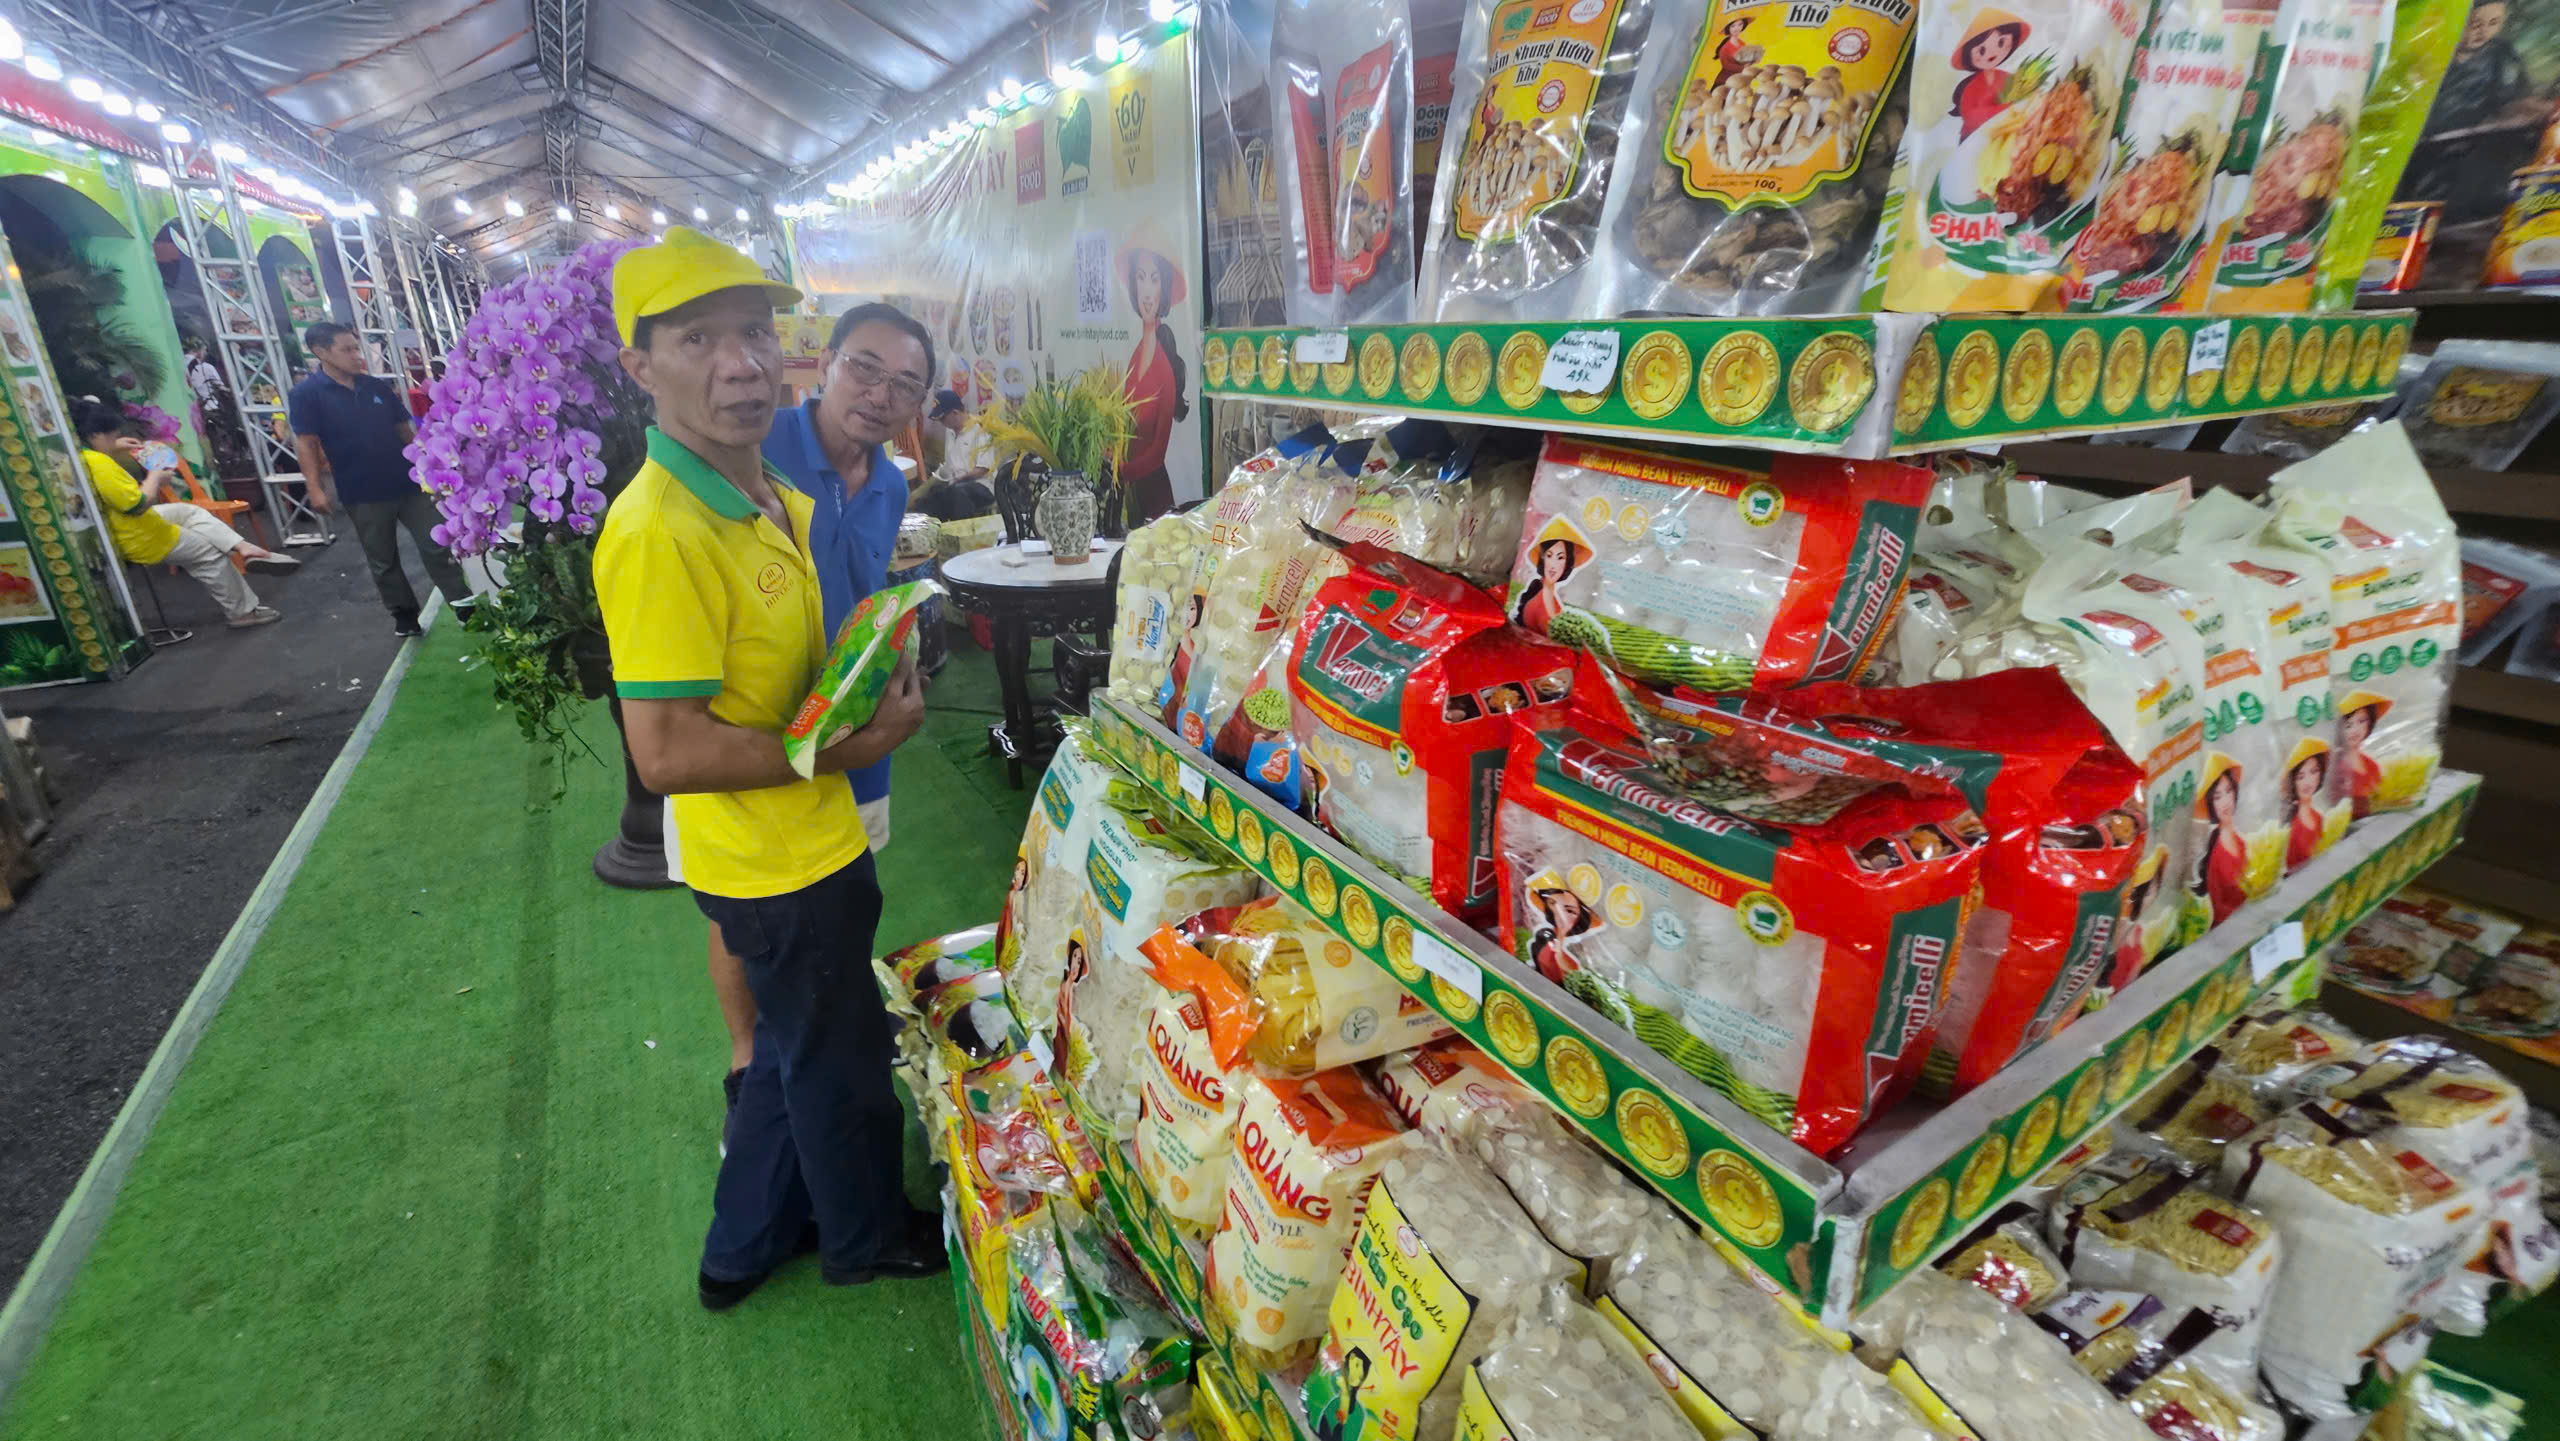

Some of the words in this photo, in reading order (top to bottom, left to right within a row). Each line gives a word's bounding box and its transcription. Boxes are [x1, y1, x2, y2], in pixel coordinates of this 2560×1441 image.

[1789, 4, 1831, 24] Khô
[1514, 39, 1555, 63] Nhung
[1515, 62, 1542, 83] Khô
[1120, 89, 1141, 130] 60
[1020, 171, 1041, 193] FOOD
[1754, 178, 1777, 191] 100
[2117, 277, 2166, 299] SHARE
[1615, 458, 1641, 477] MUNG
[1642, 464, 1670, 483] BEAN
[1671, 471, 1731, 496] VERMICELLI
[1255, 555, 1304, 632] Vermicelli
[1808, 526, 1906, 680] Vermicelli
[1629, 841, 1657, 868] BEAN
[1658, 855, 1725, 900] VERMICELLI
[1420, 1056, 1441, 1082] FOOD
[1266, 1214, 1305, 1237] STYLE
[1359, 1230, 1388, 1291] Bún
[1391, 1284, 1424, 1341] Gạo
[1389, 1251, 1410, 1284] Rice
[1408, 1276, 1448, 1334] Noodles
